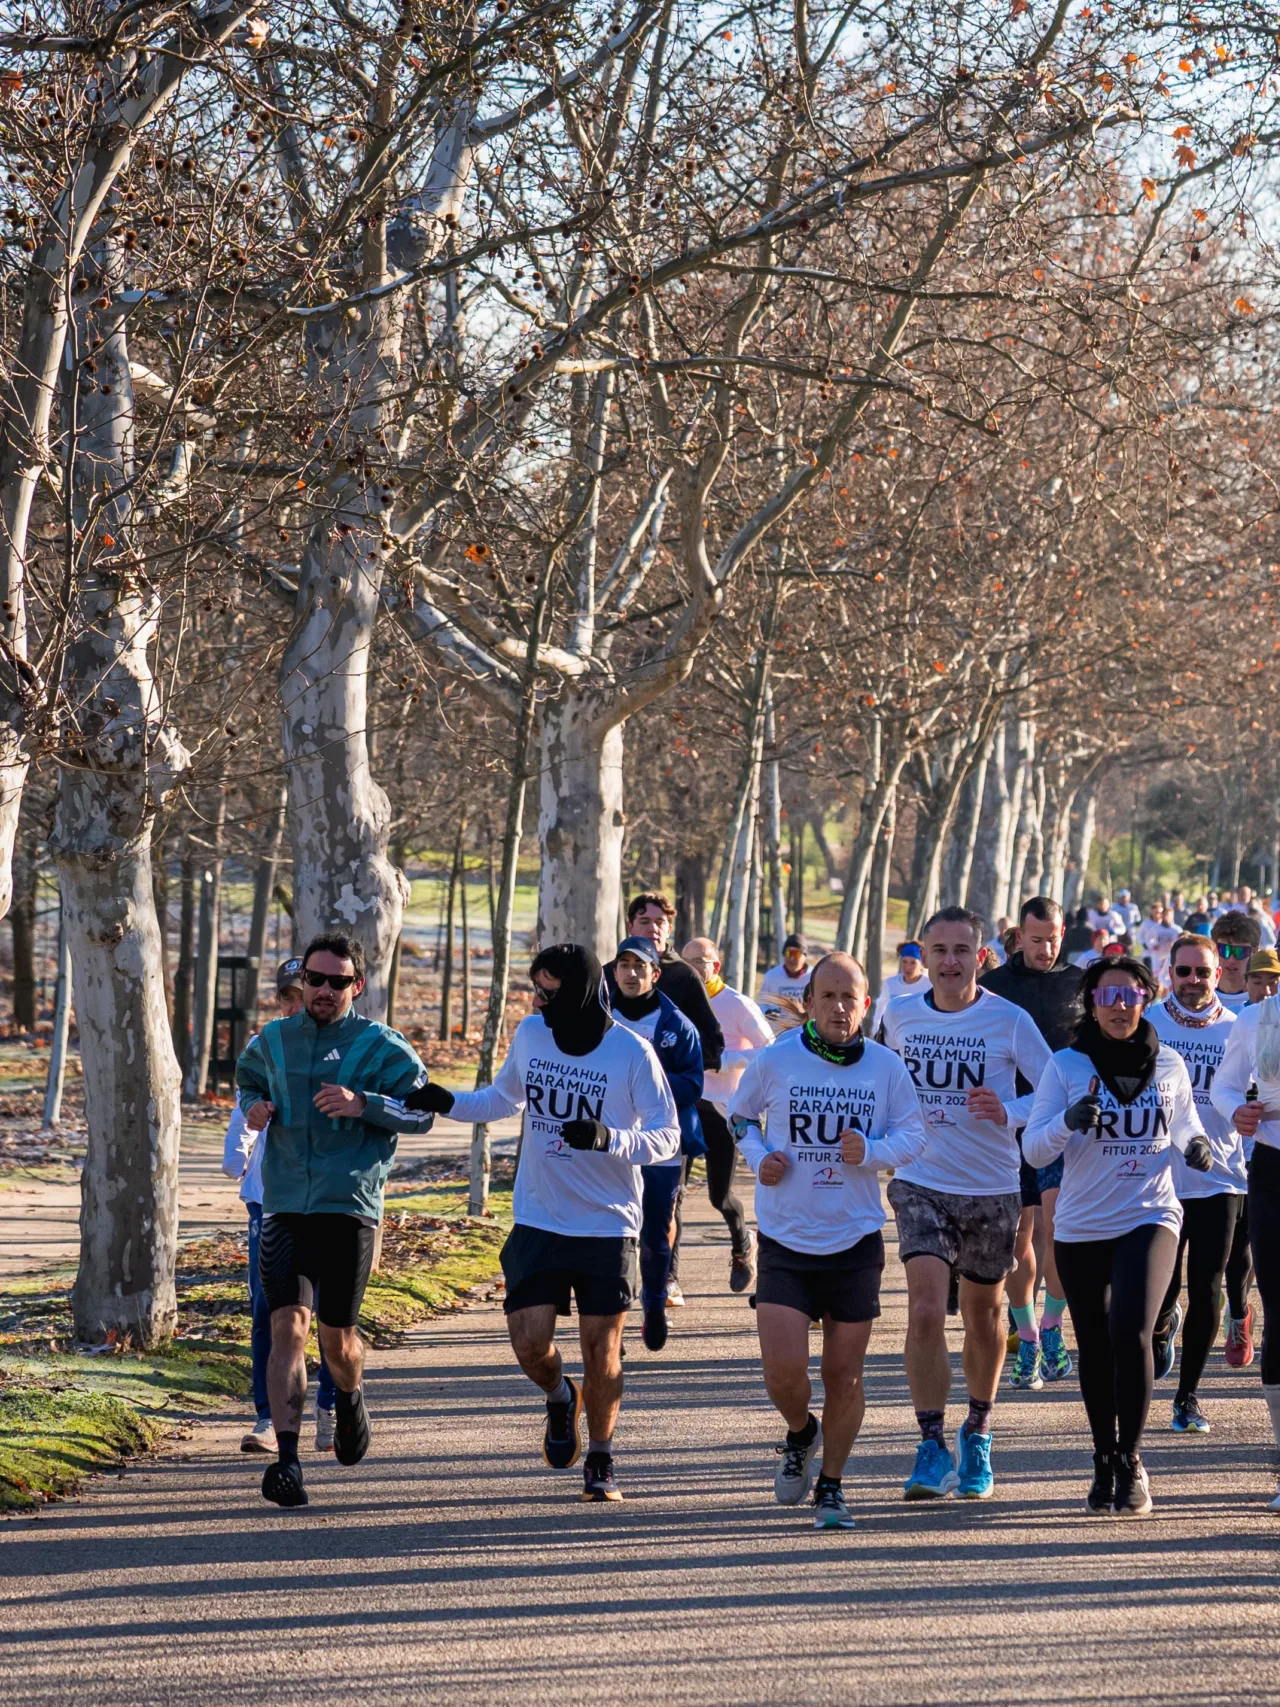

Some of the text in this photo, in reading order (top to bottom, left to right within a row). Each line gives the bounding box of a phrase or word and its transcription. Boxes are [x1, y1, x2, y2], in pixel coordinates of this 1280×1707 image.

[904, 1045, 986, 1063] RARÁMURI
[1159, 1040, 1226, 1056] HIHUAHU
[529, 1058, 608, 1084] CHIHUAHUA
[904, 1057, 985, 1090] RUN
[526, 1070, 606, 1099] RARÁMURI
[790, 1086, 876, 1101] CHIHUAHUA
[525, 1084, 604, 1122] RUN
[789, 1098, 875, 1118] RARÁMURI
[945, 1095, 967, 1106] 202
[531, 1121, 562, 1135] FITUR
[790, 1114, 873, 1145] RUN
[1096, 1108, 1173, 1140] RUN
[798, 1151, 831, 1162] FITUR
[1102, 1145, 1137, 1156] FITUR
